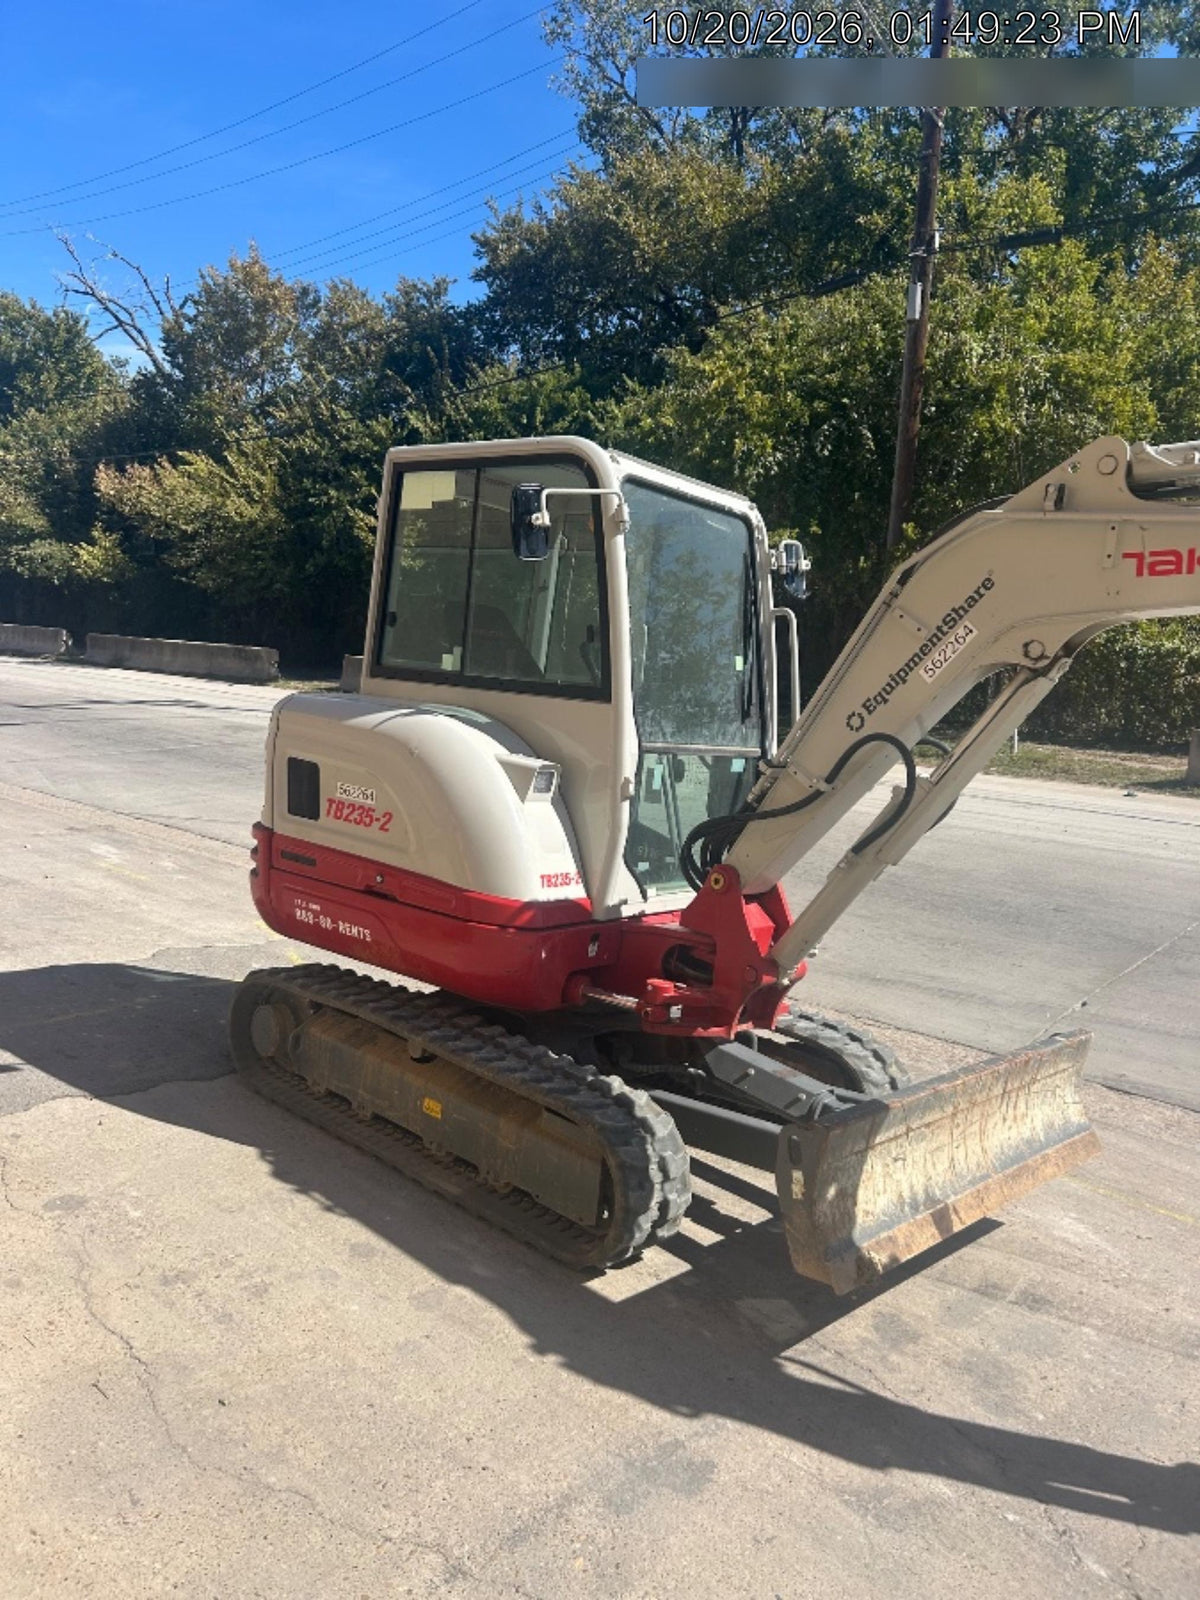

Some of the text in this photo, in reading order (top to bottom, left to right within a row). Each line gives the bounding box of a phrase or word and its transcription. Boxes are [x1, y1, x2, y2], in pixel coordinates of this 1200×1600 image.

[862, 576, 995, 716] EquipmentShare
[923, 624, 975, 679] 562264
[339, 783, 375, 802] 562264
[326, 797, 393, 833] TB235-2
[540, 870, 582, 889] TB235-2
